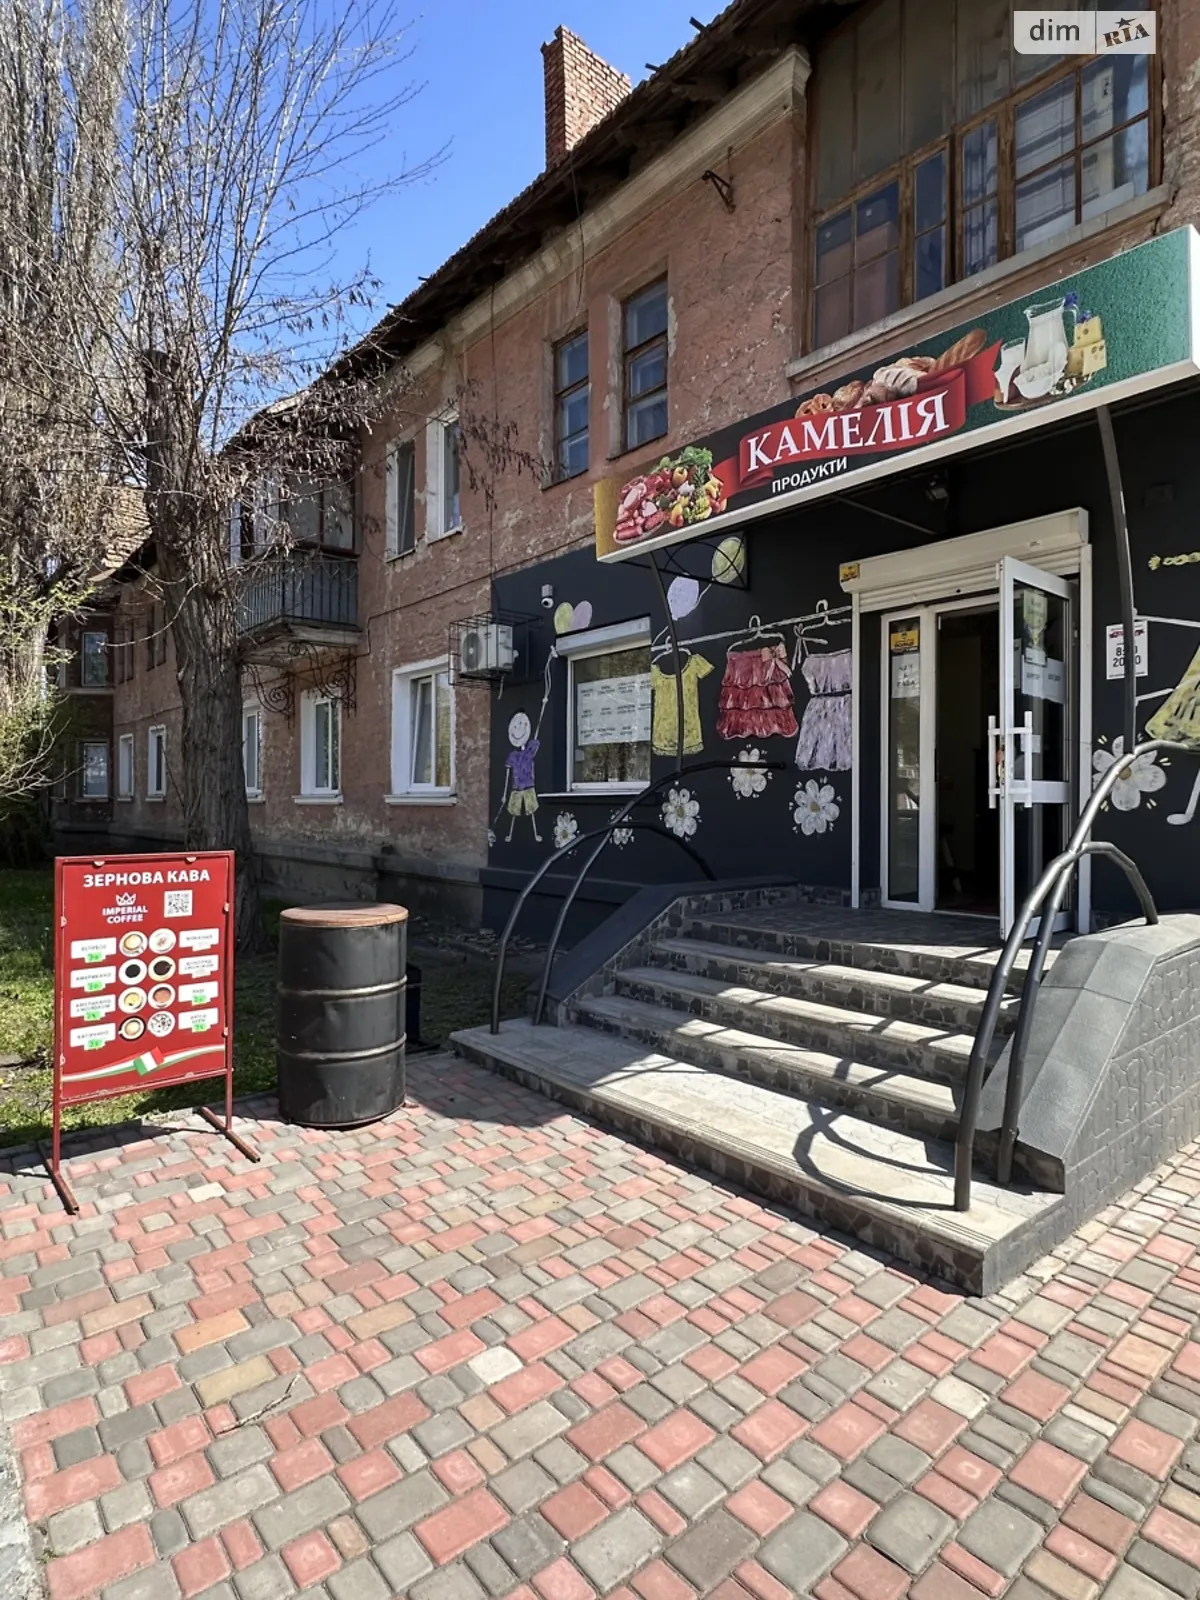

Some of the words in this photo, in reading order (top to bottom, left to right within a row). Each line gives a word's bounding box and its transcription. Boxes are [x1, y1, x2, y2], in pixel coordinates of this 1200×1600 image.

[747, 390, 950, 472] КАМЕЛІЯ
[771, 456, 848, 494] ПРОДУКТИ
[83, 871, 164, 888] ЗЕРНОВА
[167, 869, 211, 883] КАВА
[102, 905, 148, 916] IMPERIAL
[107, 914, 144, 924] COFFEE
